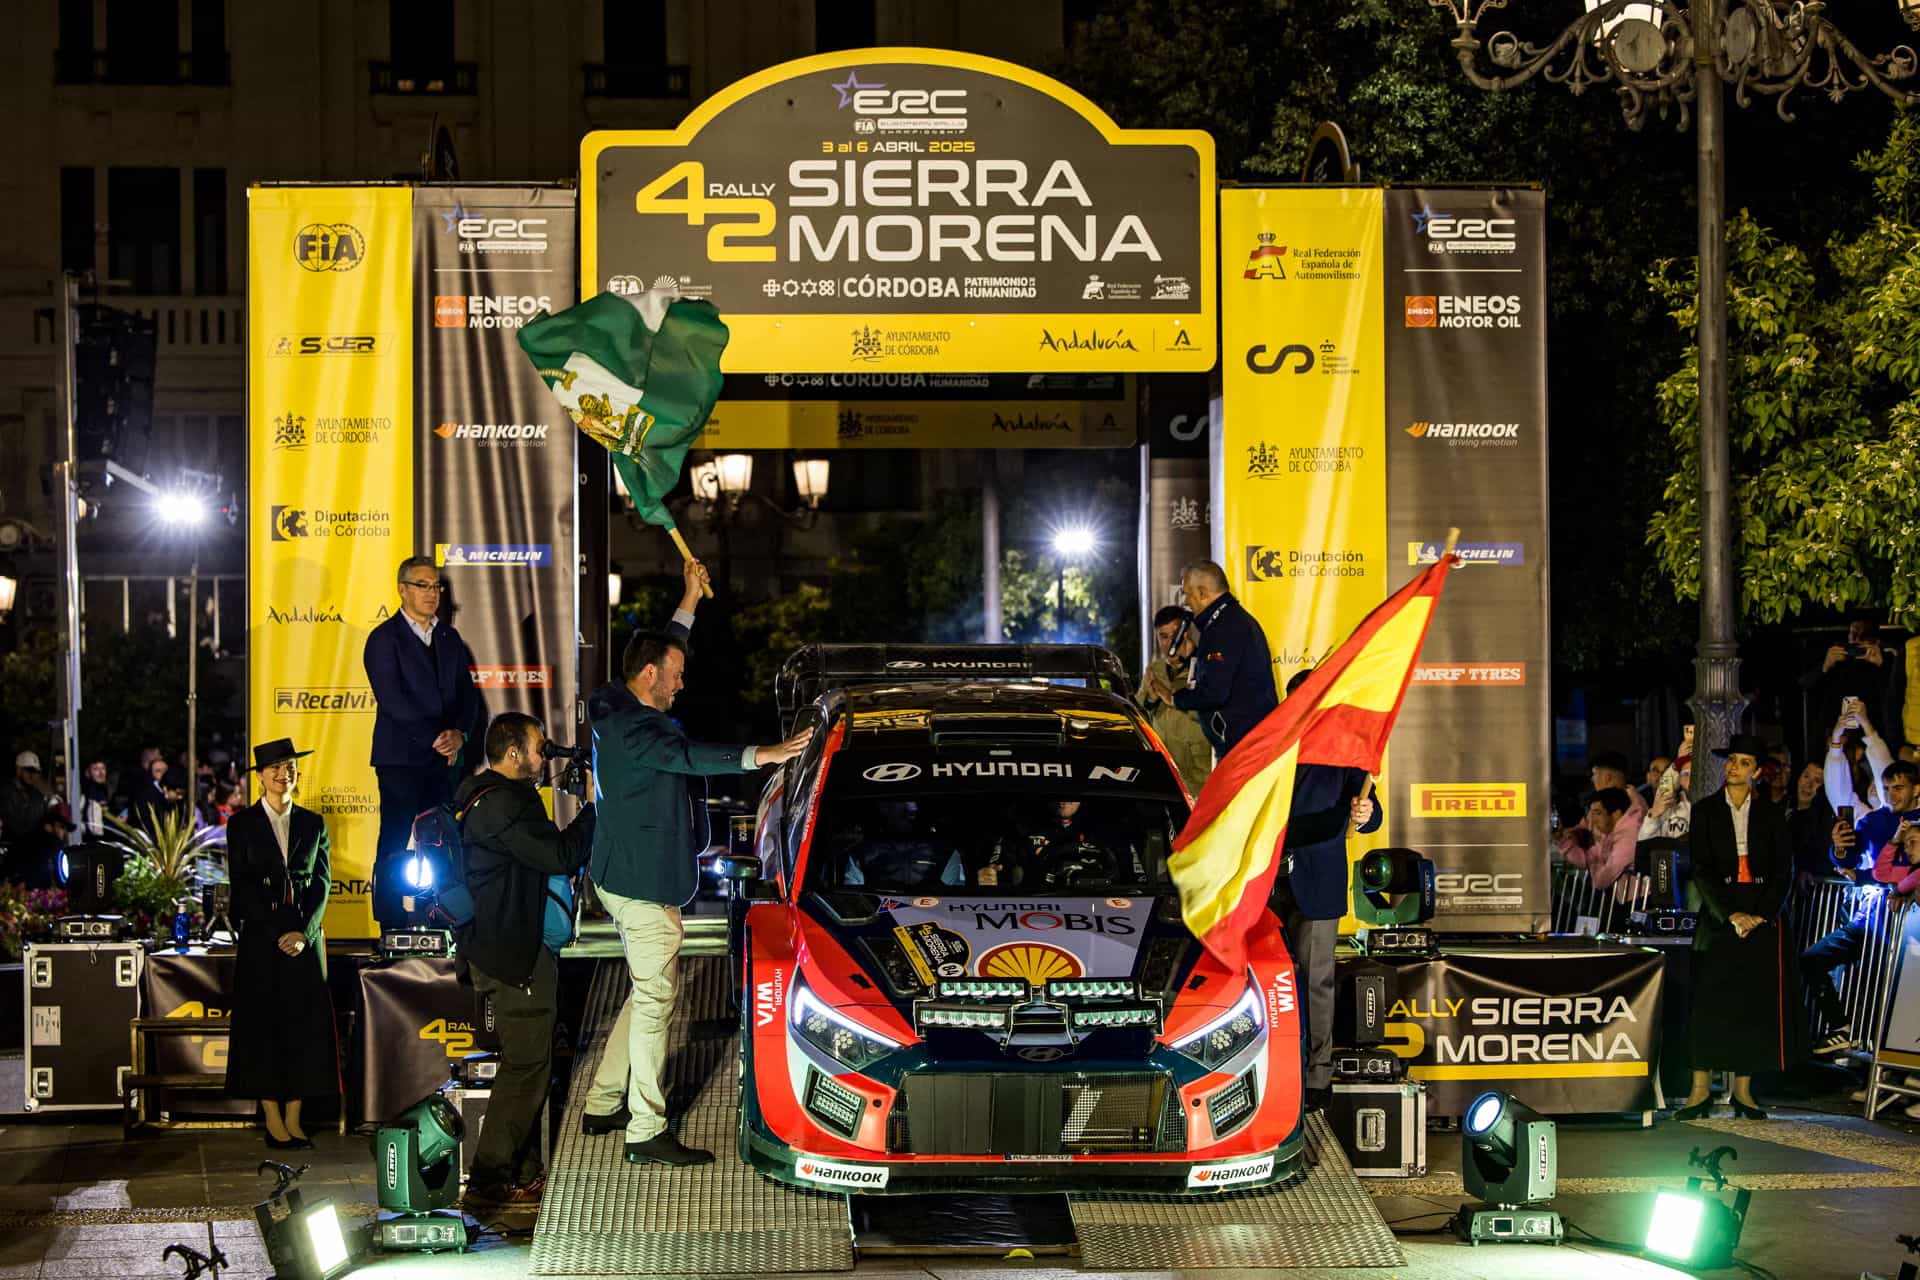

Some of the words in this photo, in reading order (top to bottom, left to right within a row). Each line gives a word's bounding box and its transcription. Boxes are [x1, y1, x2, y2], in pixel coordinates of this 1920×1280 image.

[853, 90, 968, 114] ERC
[822, 141, 833, 152] 3
[838, 141, 852, 152] al
[857, 141, 868, 152] 6
[873, 141, 925, 153] ABRIL
[928, 141, 976, 153] 2025
[709, 182, 776, 197] RALLY
[789, 160, 1093, 207] SIERRA
[636, 161, 777, 263] 42
[458, 219, 547, 238] ERC
[1428, 219, 1516, 238] ERC
[789, 215, 1162, 262] MORENA
[1293, 248, 1312, 257] Real
[1314, 247, 1361, 257] Federación
[1343, 259, 1353, 269] de
[964, 276, 1029, 287] PATRIMONIO
[1295, 270, 1360, 280] Automovilismo
[843, 273, 960, 299] CÓRDOBA
[964, 287, 1037, 299] HUMANIDAD
[469, 296, 552, 315] ENEOS
[1439, 295, 1521, 314] ENEOS
[469, 316, 523, 328] MOTOR
[1440, 316, 1493, 328] MOTOR
[1497, 316, 1521, 328] OIL
[885, 331, 951, 342] AYUNTAMIENTO
[1038, 328, 1140, 353] Andalucía
[885, 345, 895, 356] DE
[897, 343, 940, 356] CÓRDOBA
[315, 417, 391, 431] AYUNTAMIENTO
[315, 432, 332, 443] DE
[478, 440, 508, 450] driving
[510, 439, 547, 448] emotion
[1448, 438, 1479, 448] driving
[1481, 438, 1518, 447] emotion
[1289, 447, 1364, 459] AYUNTAMIENTO
[1289, 461, 1302, 472] DE
[314, 508, 390, 527] Diputación
[314, 524, 332, 537] de
[334, 523, 391, 538] Córdoba
[469, 551, 543, 560] MICHELIN
[1289, 550, 1364, 567] Diputación
[1289, 565, 1305, 577] de
[1308, 563, 1365, 578] Córdoba
[266, 605, 347, 625] Andalucía
[495, 671, 548, 683] TYRES
[1414, 668, 1466, 680] MRF
[1468, 668, 1521, 680] TYRES
[295, 691, 368, 710] Recalvi
[932, 762, 1072, 778] HYUNDAI
[321, 795, 374, 804] CATEDRAL
[1422, 790, 1516, 811] PIRELLI
[321, 805, 335, 815] DE
[948, 903, 1061, 912] HYUNDAI
[975, 911, 1136, 935] MOBIS
[921, 934, 945, 965] MORENA
[930, 933, 950, 958] SIERRA
[774, 968, 783, 1006] HYUNDAI
[1267, 989, 1279, 1028] HYUNDAI
[1384, 998, 1465, 1017] ALLY
[1472, 995, 1637, 1026] SIERRA
[448, 1022, 476, 1031] RAL
[1436, 1032, 1641, 1063] MORENA
